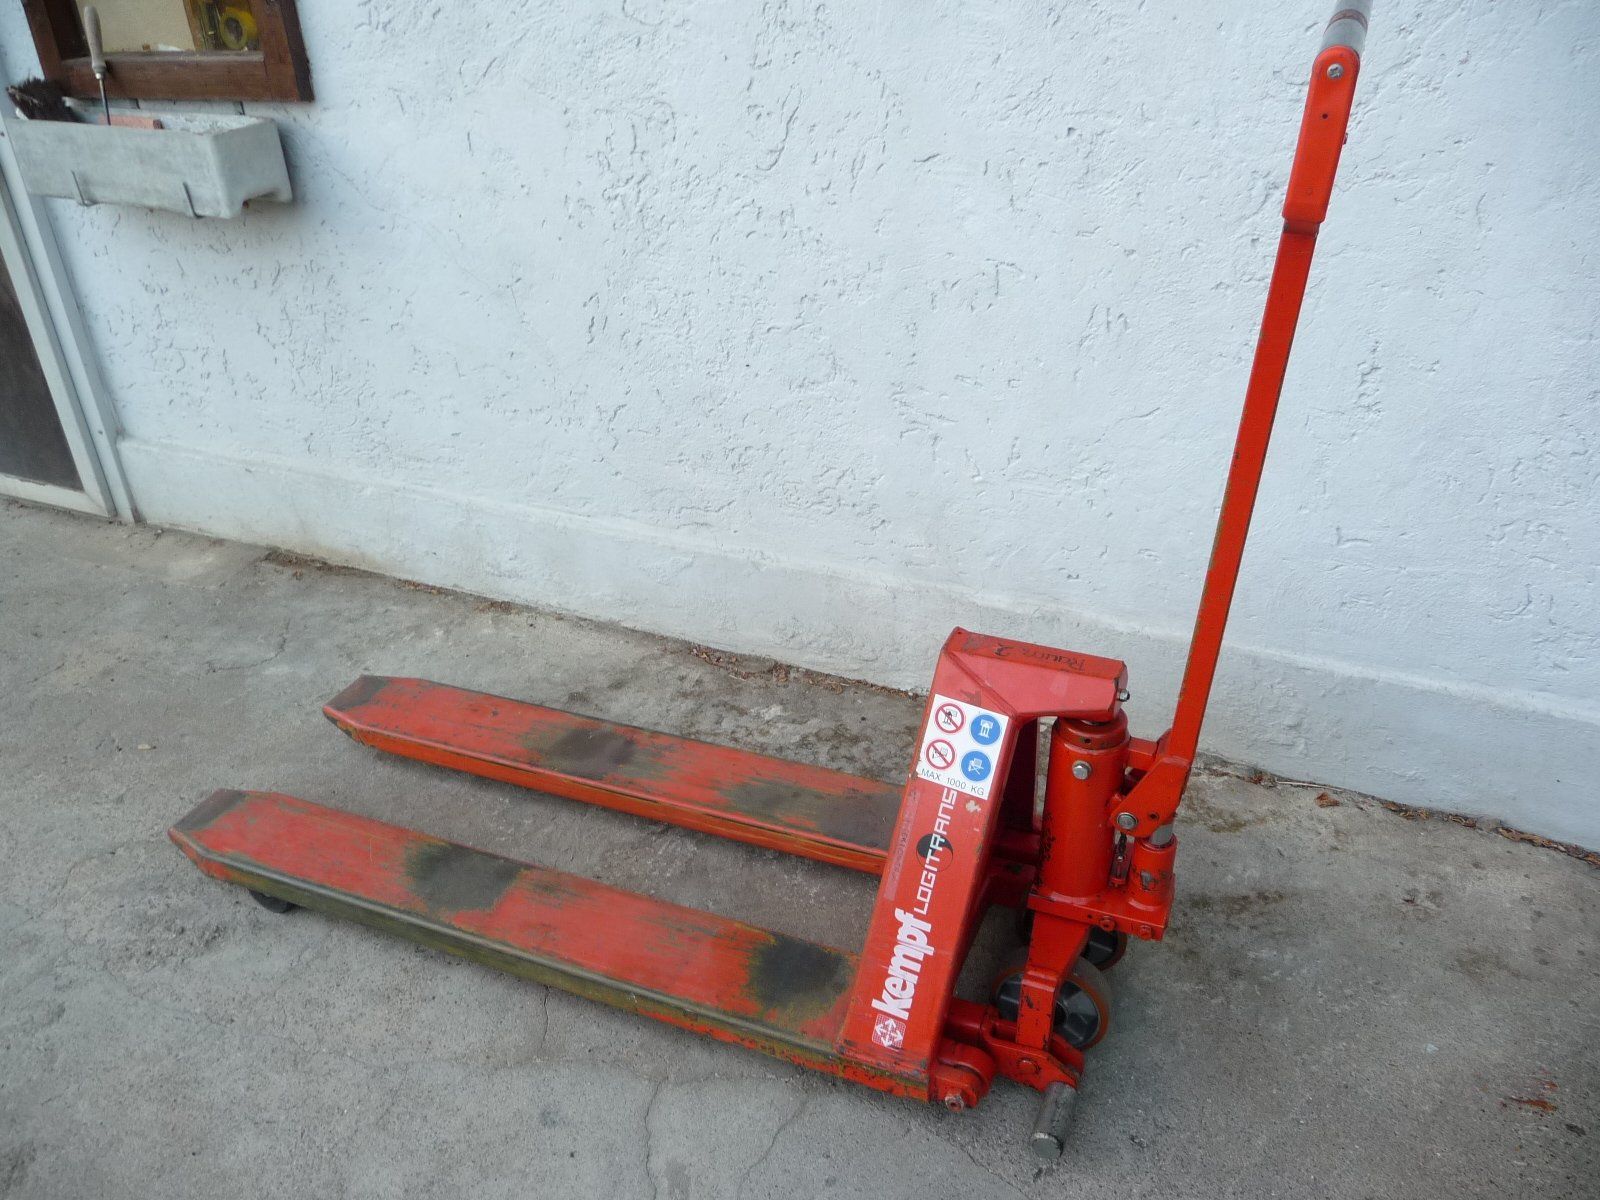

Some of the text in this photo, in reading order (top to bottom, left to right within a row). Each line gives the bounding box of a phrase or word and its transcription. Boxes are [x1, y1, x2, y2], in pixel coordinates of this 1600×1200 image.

[921, 768, 985, 796] MAX 1000 KG
[914, 787, 957, 916] LOGITRANS
[871, 907, 935, 1020] kempf
